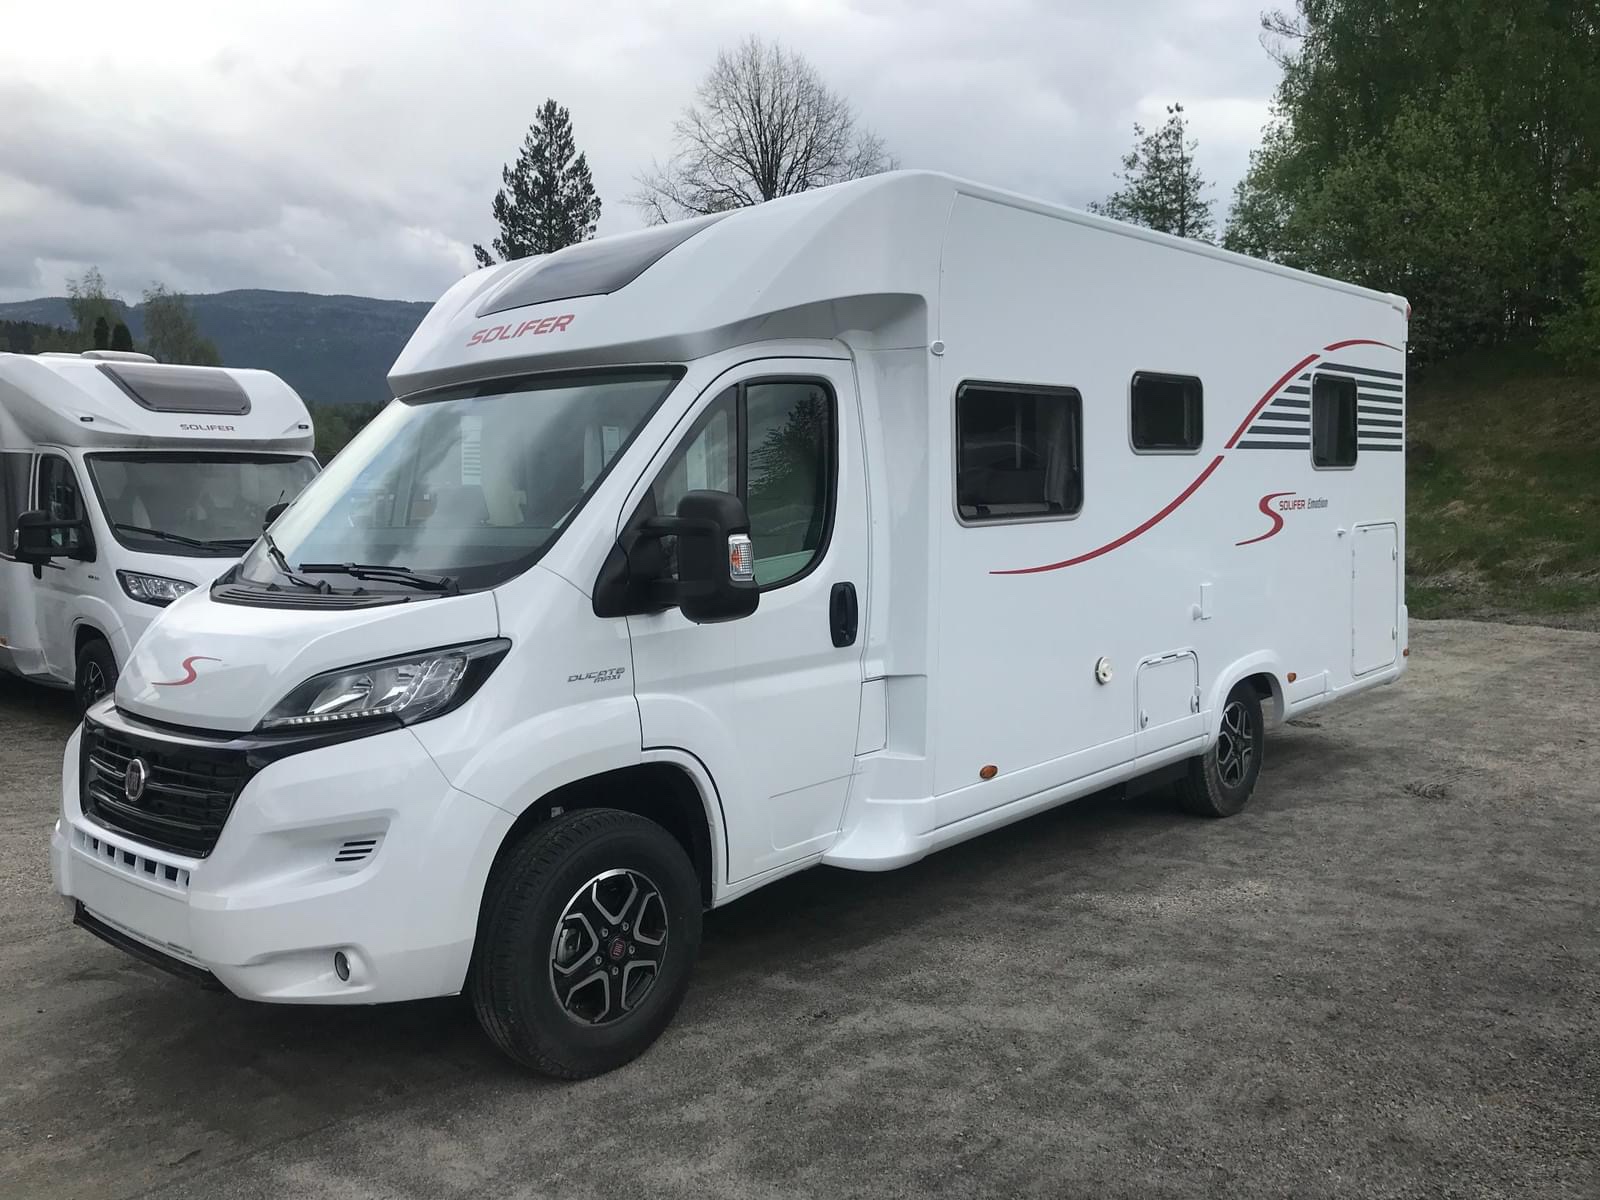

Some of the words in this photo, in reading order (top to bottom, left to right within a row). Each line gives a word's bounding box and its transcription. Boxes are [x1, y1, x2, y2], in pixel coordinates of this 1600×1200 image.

[466, 314, 575, 347] SOLIFER
[1279, 500, 1305, 511] SOLIFER
[567, 667, 625, 682] DUCATO
